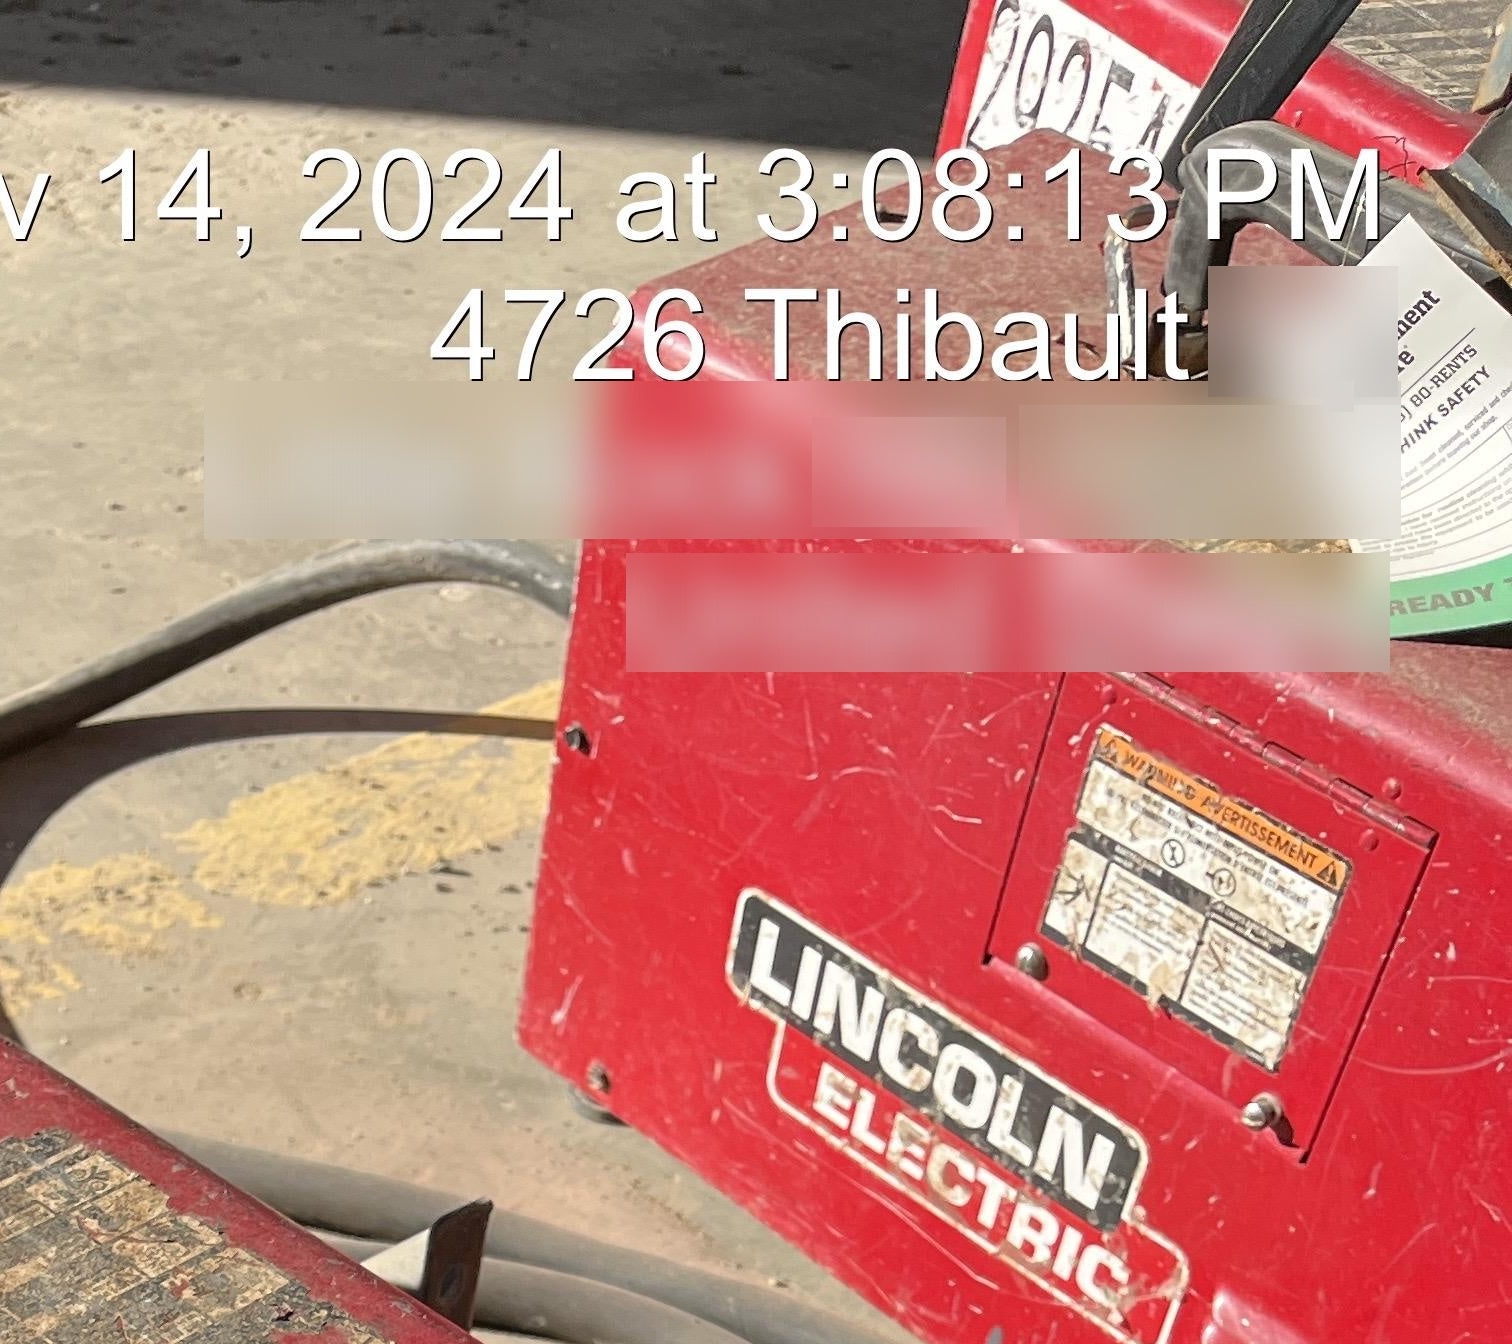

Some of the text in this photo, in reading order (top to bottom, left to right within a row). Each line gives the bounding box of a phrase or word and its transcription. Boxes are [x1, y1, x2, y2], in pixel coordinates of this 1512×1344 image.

[1438, 365, 1490, 417] SAFETY
[1389, 582, 1495, 617] READY
[1200, 795, 1319, 869] AVERTISSEMENT
[750, 917, 1116, 1211] LINCOLN
[812, 1061, 1130, 1326] ELECTRIC
